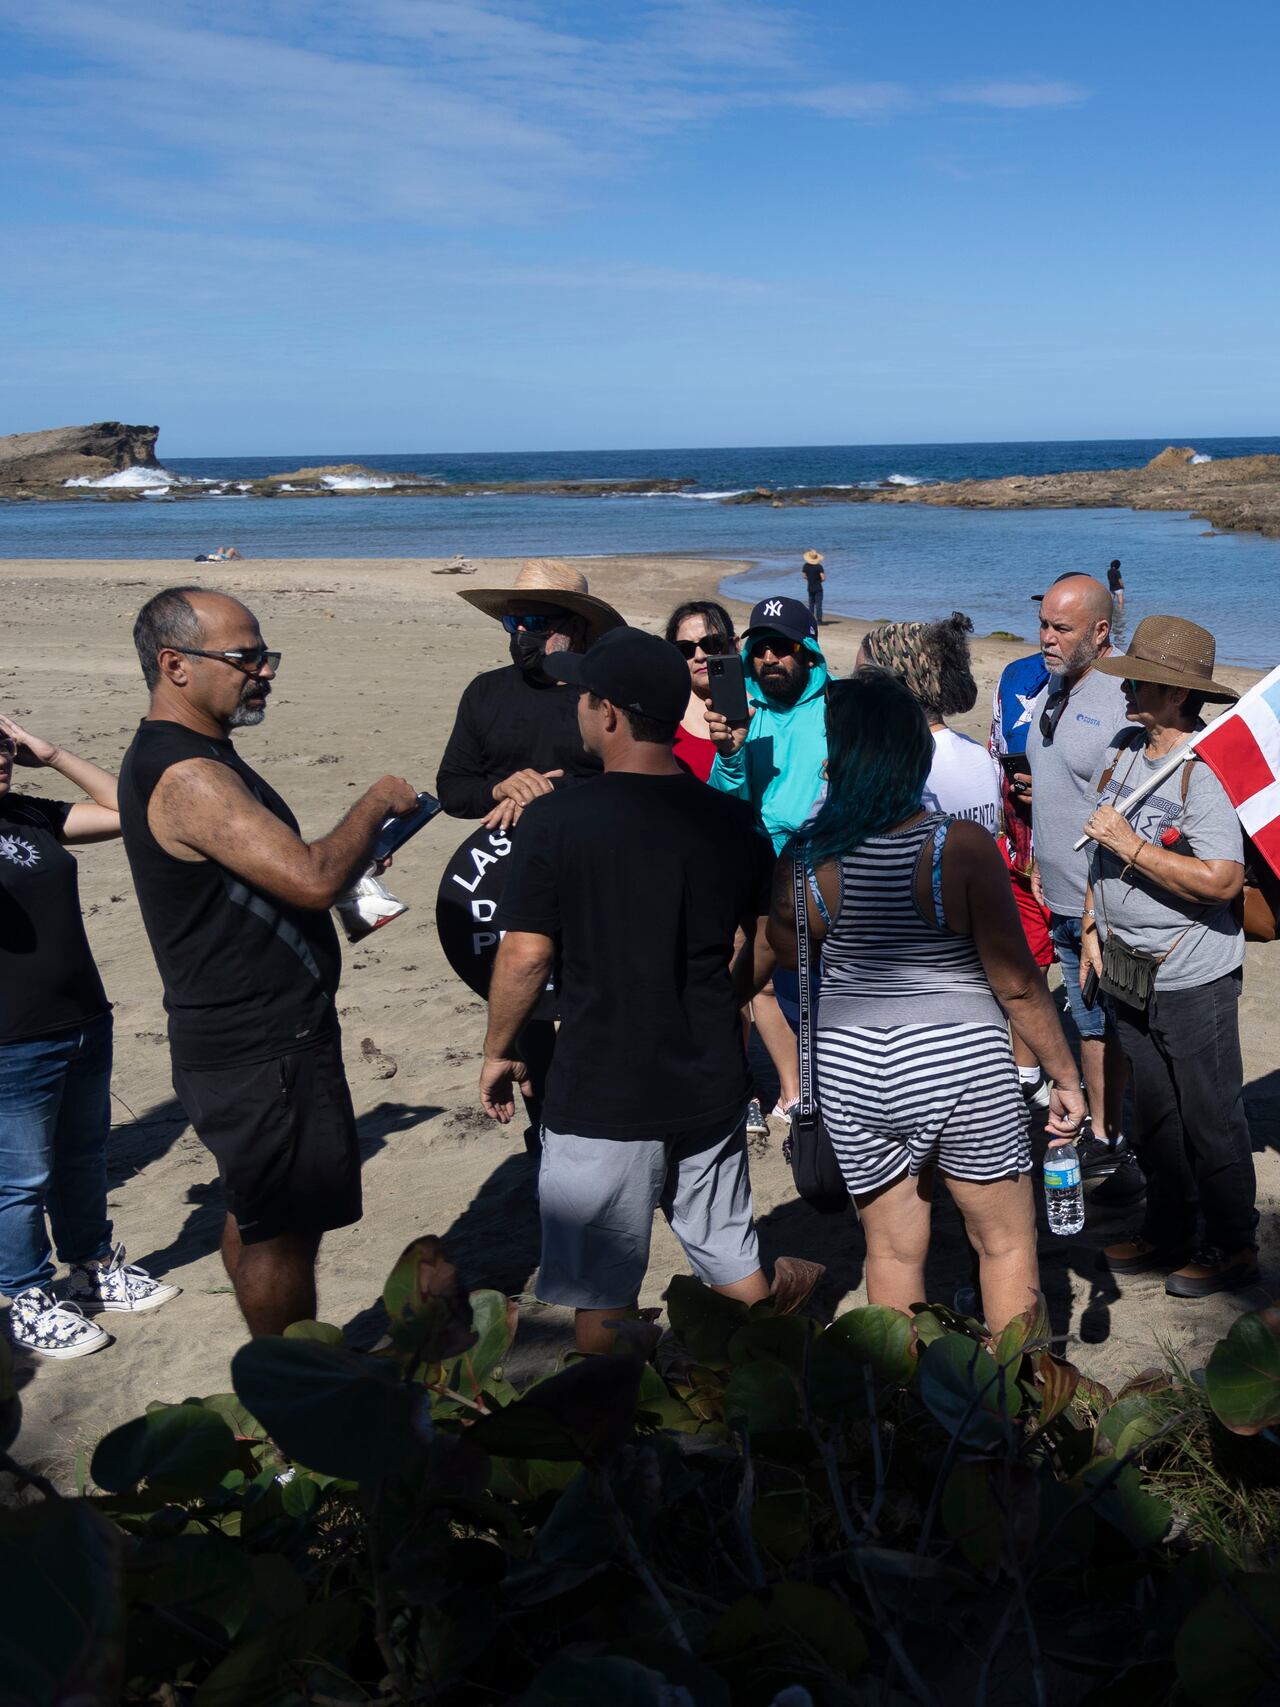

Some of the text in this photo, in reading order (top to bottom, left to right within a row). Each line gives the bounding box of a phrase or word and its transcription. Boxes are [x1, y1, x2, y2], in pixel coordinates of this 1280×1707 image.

[763, 600, 783, 616] NY
[453, 829, 512, 893] LAS
[796, 888, 805, 927] HILFIGER
[799, 933, 807, 965] TOMMY
[802, 1061, 810, 1098] HILFIGER
